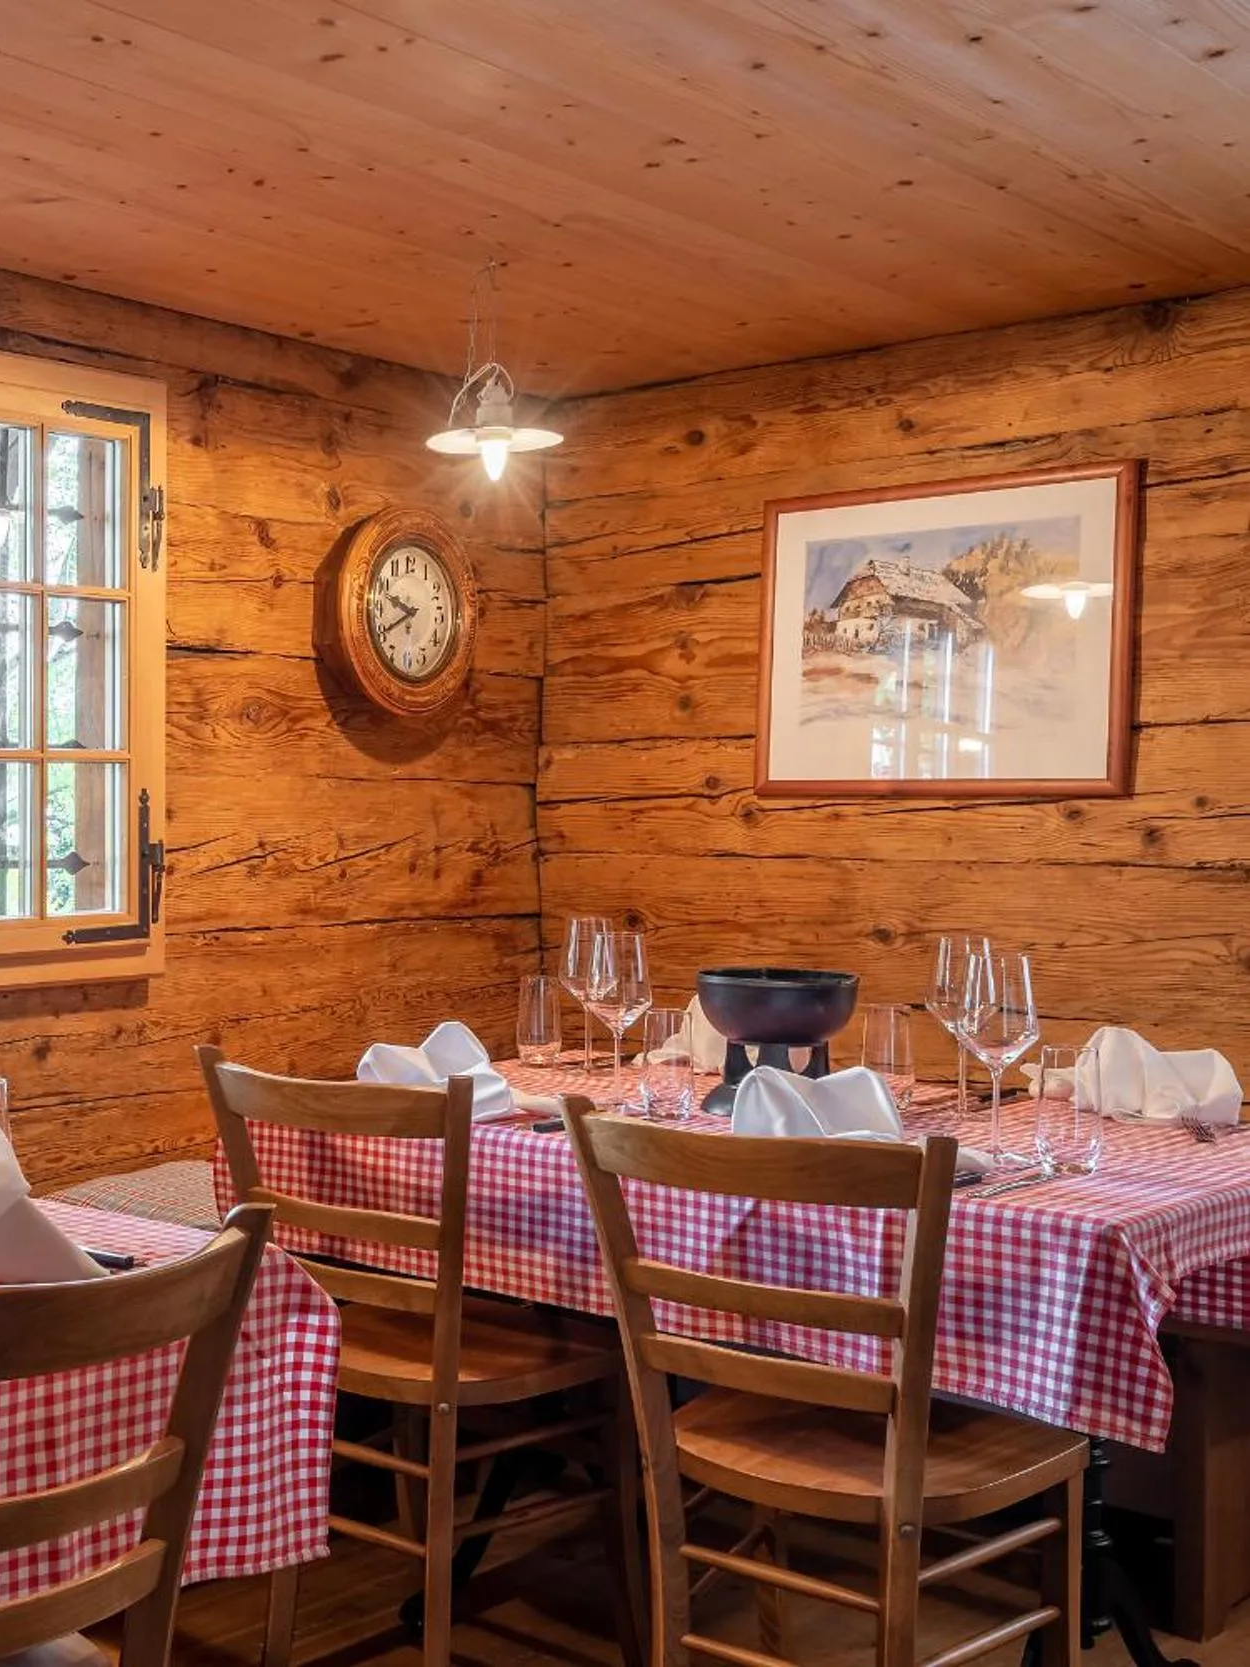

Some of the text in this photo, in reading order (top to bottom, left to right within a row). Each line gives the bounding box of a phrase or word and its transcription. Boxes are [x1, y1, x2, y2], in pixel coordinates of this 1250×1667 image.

[390, 558, 399, 577] 11
[405, 555, 416, 574] 12
[423, 563, 428, 581] 1
[431, 581, 441, 601] 2
[434, 606, 444, 625] 3
[377, 624, 387, 643] 8
[430, 628, 440, 647] 4
[403, 651, 413, 669] 6
[416, 648, 427, 666] 5
